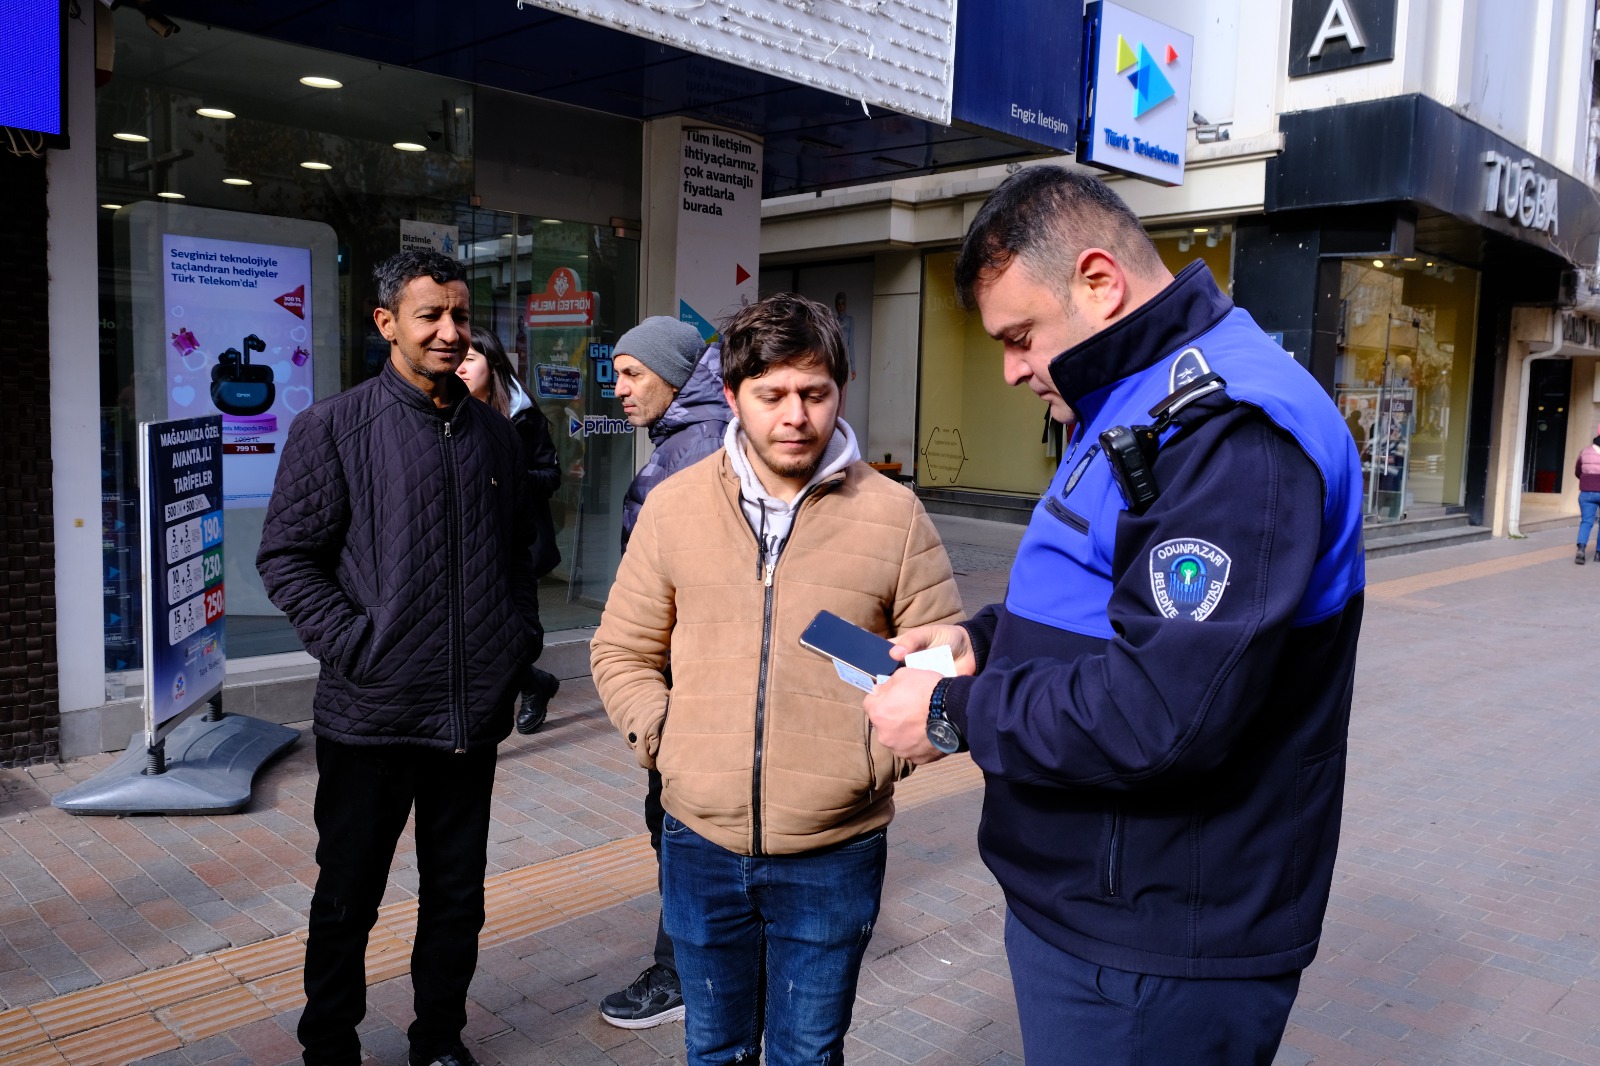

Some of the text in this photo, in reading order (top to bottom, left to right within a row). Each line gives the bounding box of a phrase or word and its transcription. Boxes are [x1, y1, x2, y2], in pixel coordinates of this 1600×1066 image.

[1307, 0, 1366, 57] A
[1011, 103, 1069, 135] Engiz İletişim
[686, 130, 752, 155] Tüm iletişim
[1104, 127, 1179, 166] Türk Telekom
[684, 145, 759, 175] ihtiyaçlarınız,
[683, 165, 754, 190] çok avantajlı
[683, 180, 735, 202] fiyatlarla
[1482, 150, 1559, 236] TUĞBA
[682, 197, 723, 216] burada
[402, 234, 432, 245] Bizimle
[170, 248, 278, 268] Sevginizi teknolojiyle
[170, 261, 279, 279] taçlandıran hediyeler
[171, 273, 258, 288] Türk Telekom'da!
[160, 423, 220, 448] MAĞAZAMIZA ÖZEL
[584, 417, 634, 436] prime
[171, 445, 213, 469] AVANTAJLI
[173, 470, 213, 494] TARİFELER
[203, 516, 219, 543] 190
[203, 553, 221, 582] 230
[1157, 543, 1225, 567] ODUNPAZARI
[206, 589, 224, 620] 250
[1153, 571, 1180, 619] BELEDİYE
[1190, 580, 1223, 622] ZABITASI
